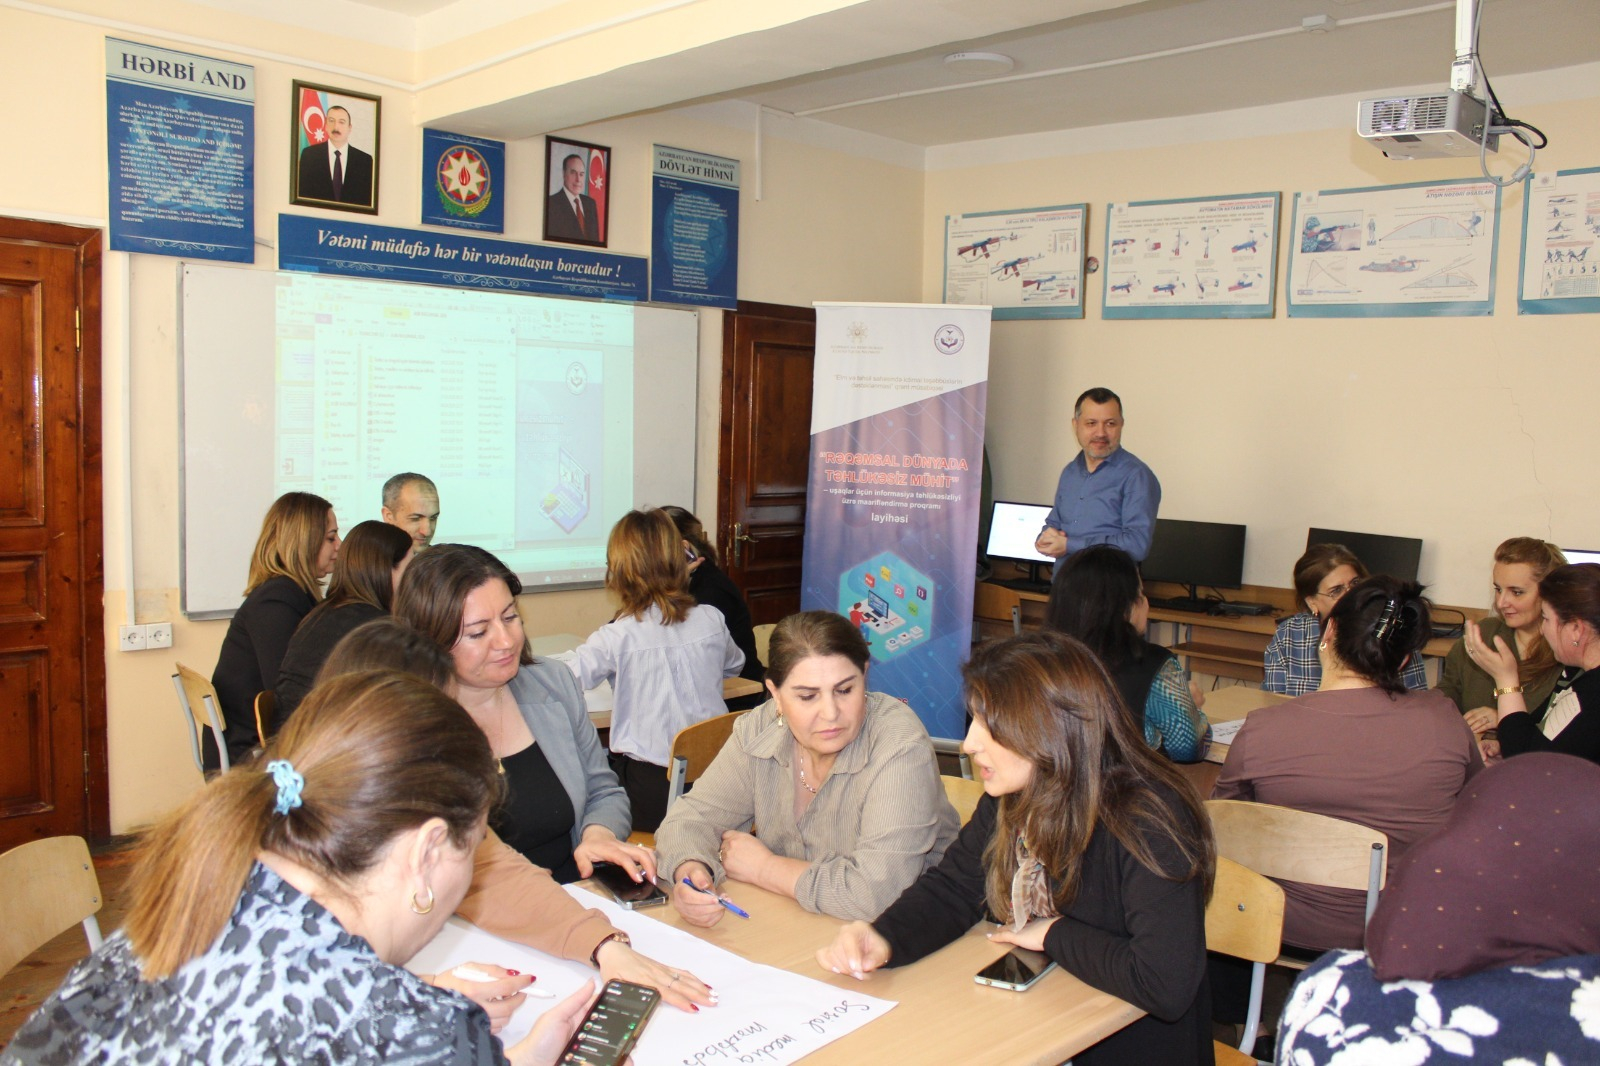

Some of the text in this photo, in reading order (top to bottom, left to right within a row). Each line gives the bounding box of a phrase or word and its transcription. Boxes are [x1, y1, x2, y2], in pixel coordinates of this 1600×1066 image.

[122, 53, 246, 90] HƏRBİ AND
[660, 159, 733, 181] DÖVLƏT HİMNİ
[318, 229, 368, 250] Vətəni
[371, 238, 430, 259] müdafiə
[434, 244, 458, 259] hər
[462, 247, 482, 262] bir
[486, 252, 553, 272] vətəndaşın
[557, 258, 613, 276] borcudur
[903, 454, 968, 471] DÜNYADA
[825, 469, 908, 485] TƏHLÜKƏSİZ
[857, 499, 908, 507] maarifləndirmə
[875, 489, 914, 499] informasiya
[916, 492, 961, 501] təhlükəsizliyi
[871, 513, 908, 523] layihəsi
[738, 1033, 798, 1064] media
